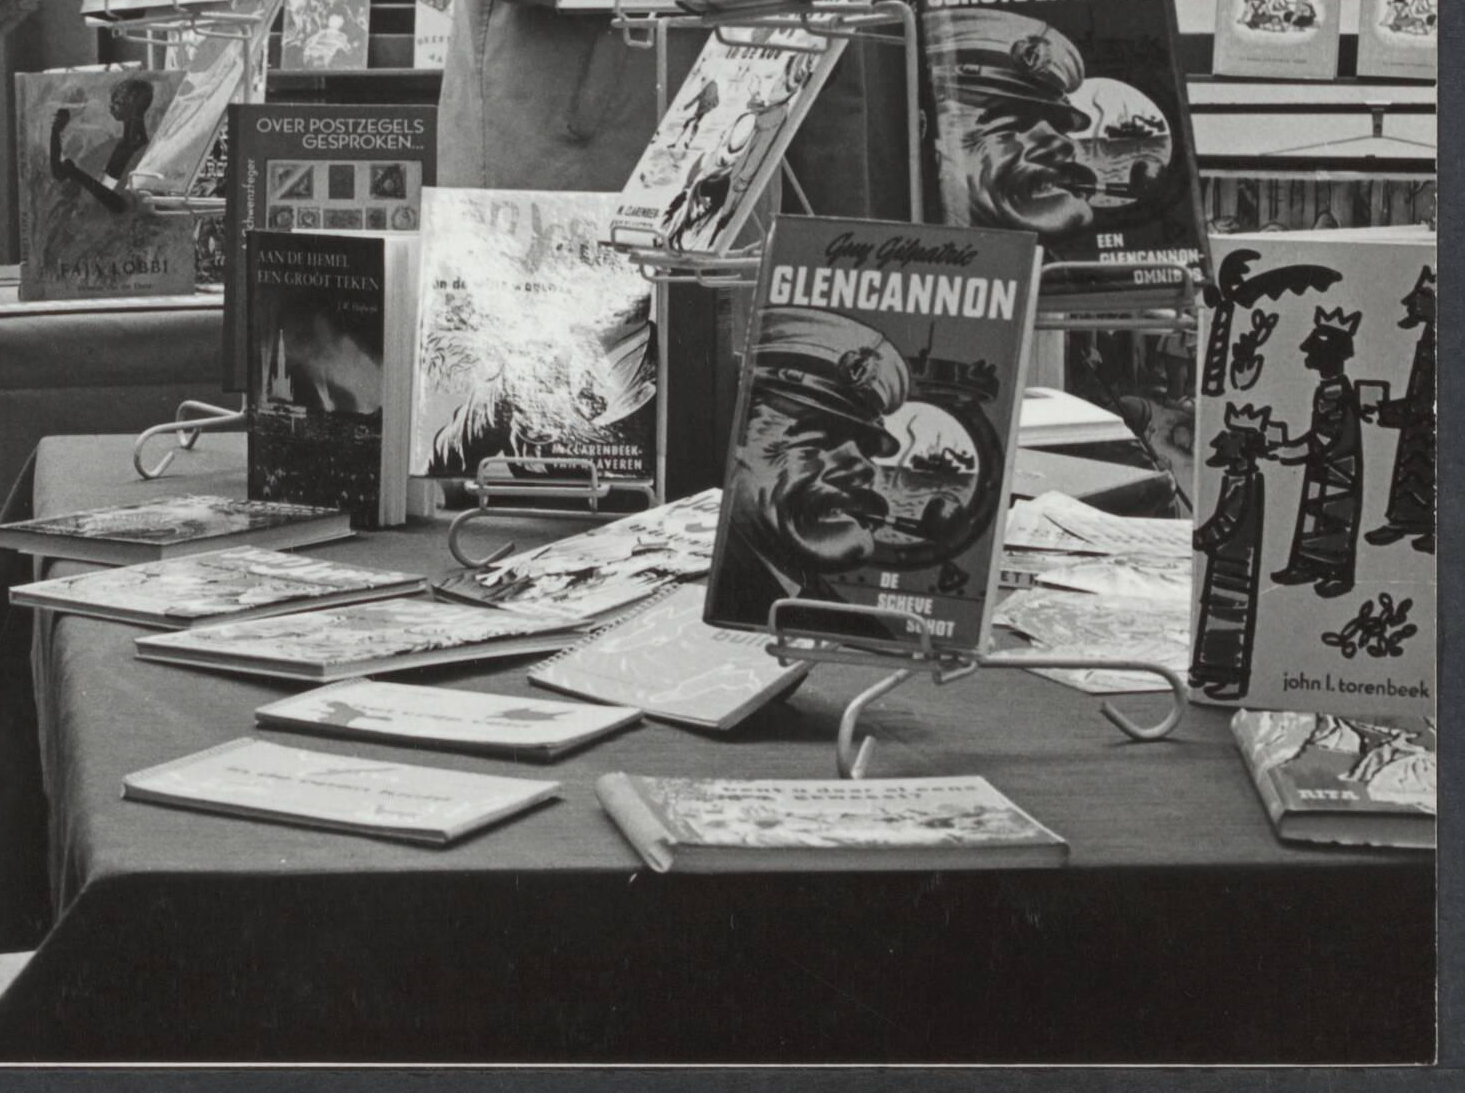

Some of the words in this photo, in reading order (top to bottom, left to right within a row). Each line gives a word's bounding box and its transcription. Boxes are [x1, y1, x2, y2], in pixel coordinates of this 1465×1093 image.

[256, 117, 306, 134] OVER
[309, 117, 425, 135] POSTZEGELS
[302, 133, 425, 150] GESPROKEN...
[1096, 232, 1125, 249] EEN
[257, 249, 285, 265] AAN
[287, 250, 304, 266] DE
[307, 251, 352, 269] HEMEL
[825, 231, 874, 269] Guy
[875, 235, 979, 270] Gilpatric
[1098, 248, 1206, 265] GLENCANNON-
[112, 259, 168, 276] LOBBI
[257, 268, 282, 285] EEN
[284, 269, 332, 288] GROOT
[334, 273, 380, 291] TEKEN
[768, 264, 1019, 321] GLENCANNON
[879, 571, 900, 590] DE
[877, 592, 935, 616] SCHEVE
[1283, 671, 1321, 692] john
[1325, 673, 1336, 692] l.
[1338, 676, 1431, 699] torenbeek
[1296, 789, 1361, 800] RITA
